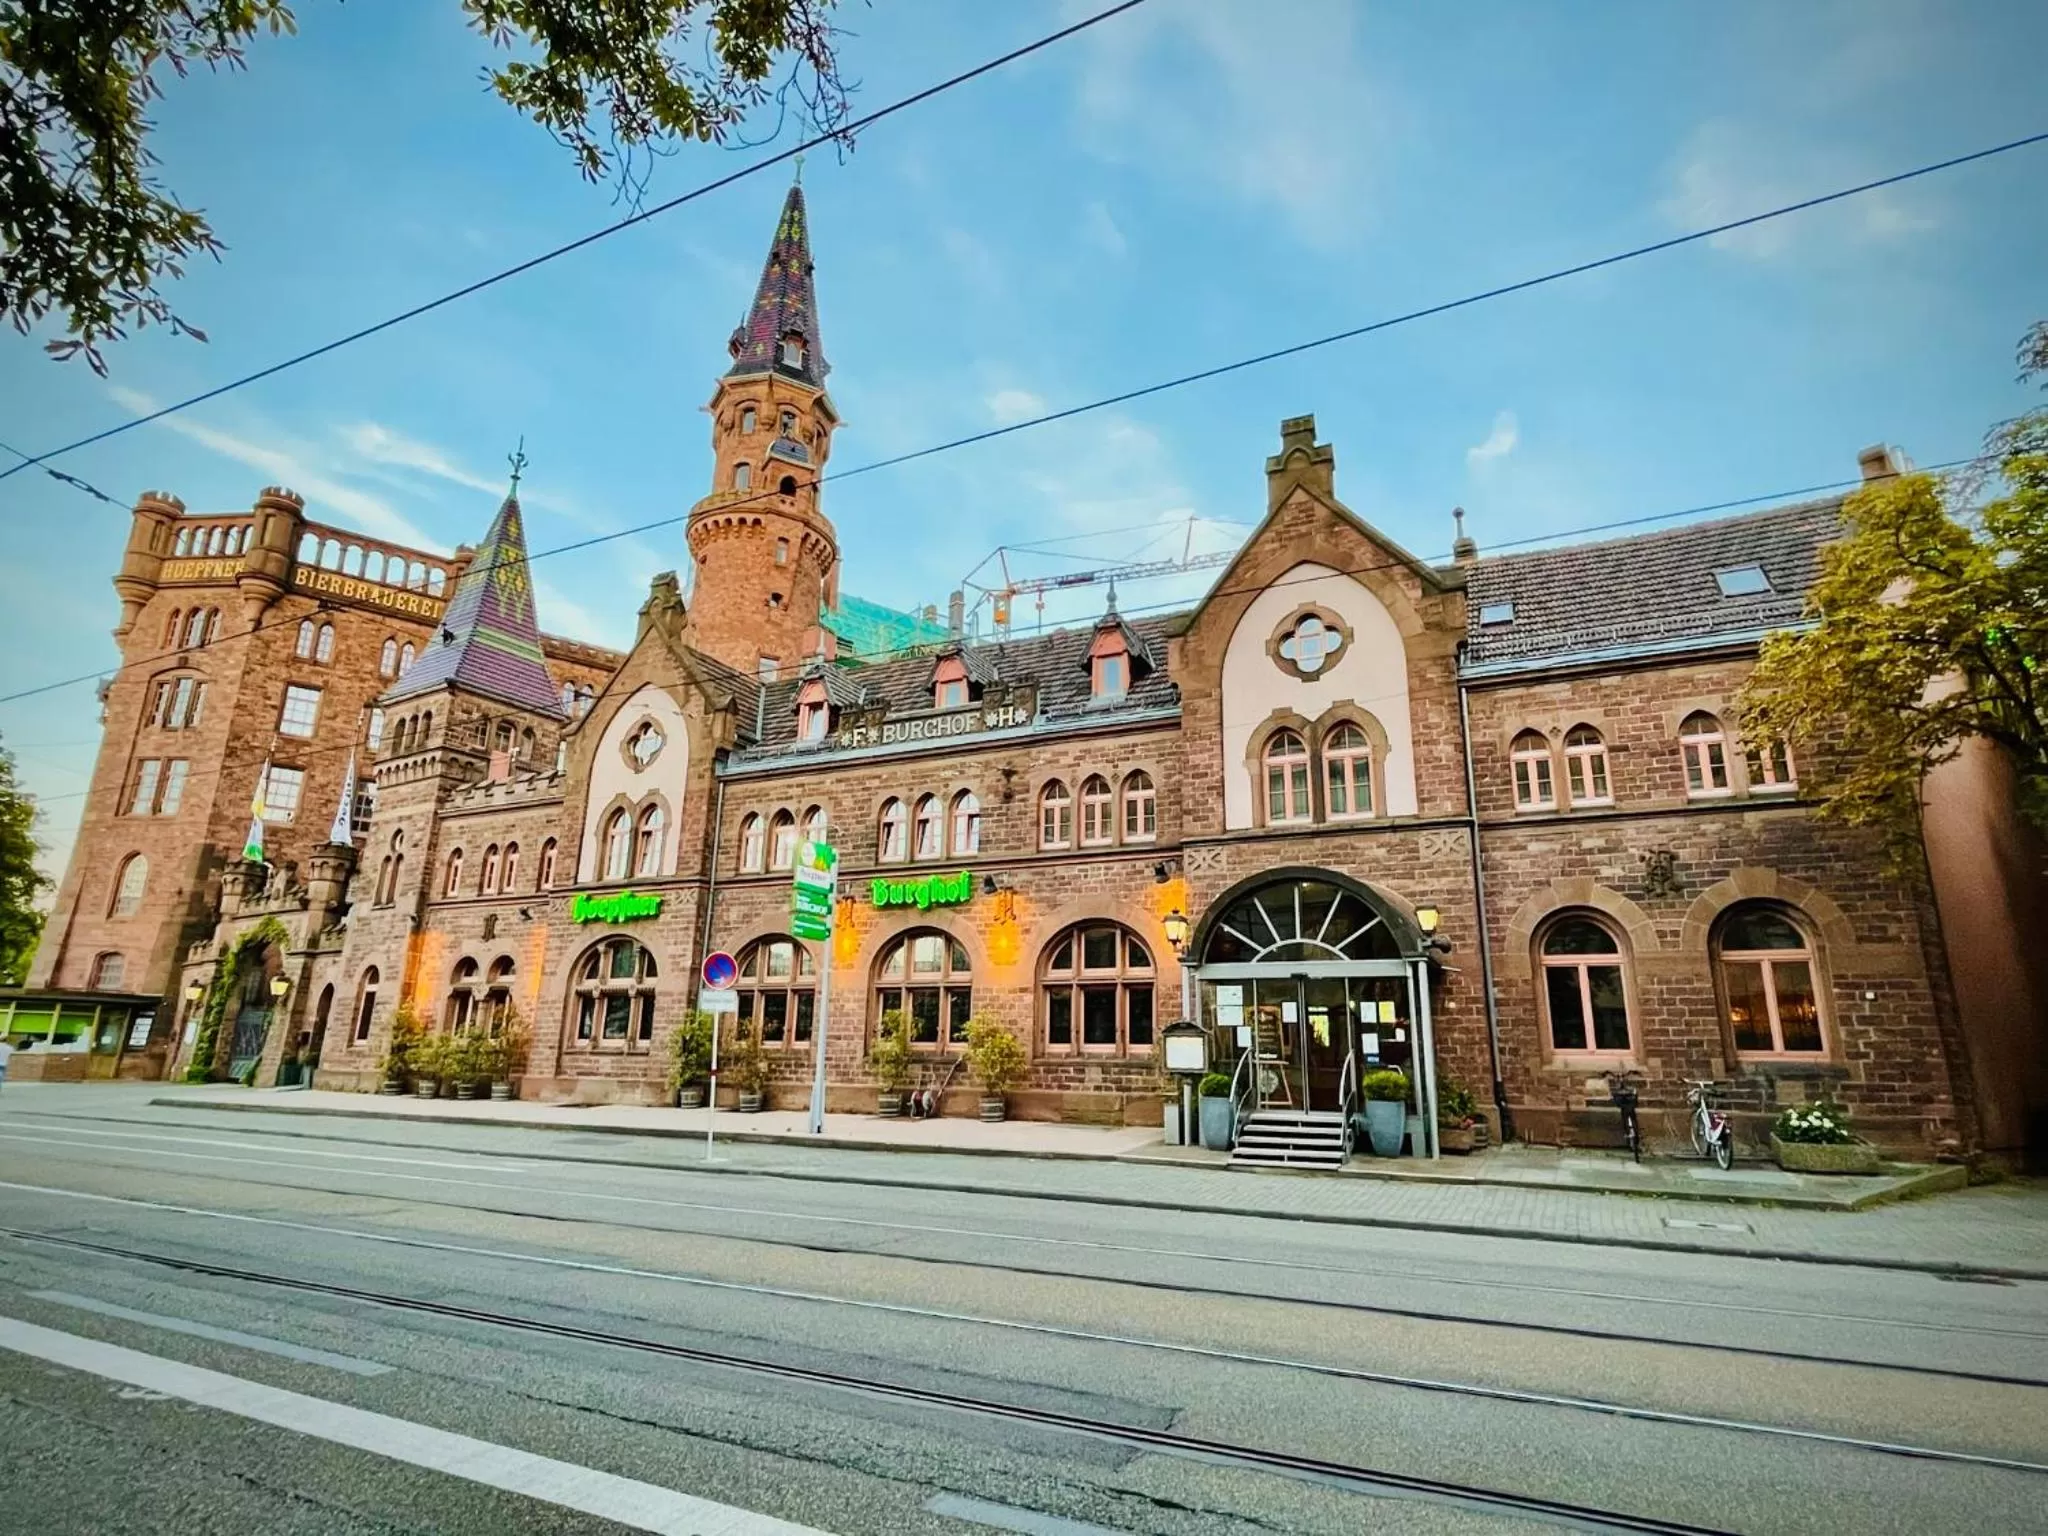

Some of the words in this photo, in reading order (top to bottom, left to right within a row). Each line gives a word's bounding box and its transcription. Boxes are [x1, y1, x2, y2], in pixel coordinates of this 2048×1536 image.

[295, 568, 440, 618] BIERBRAUEREI
[882, 711, 981, 744] BURGHOF
[871, 870, 972, 911] Burghof
